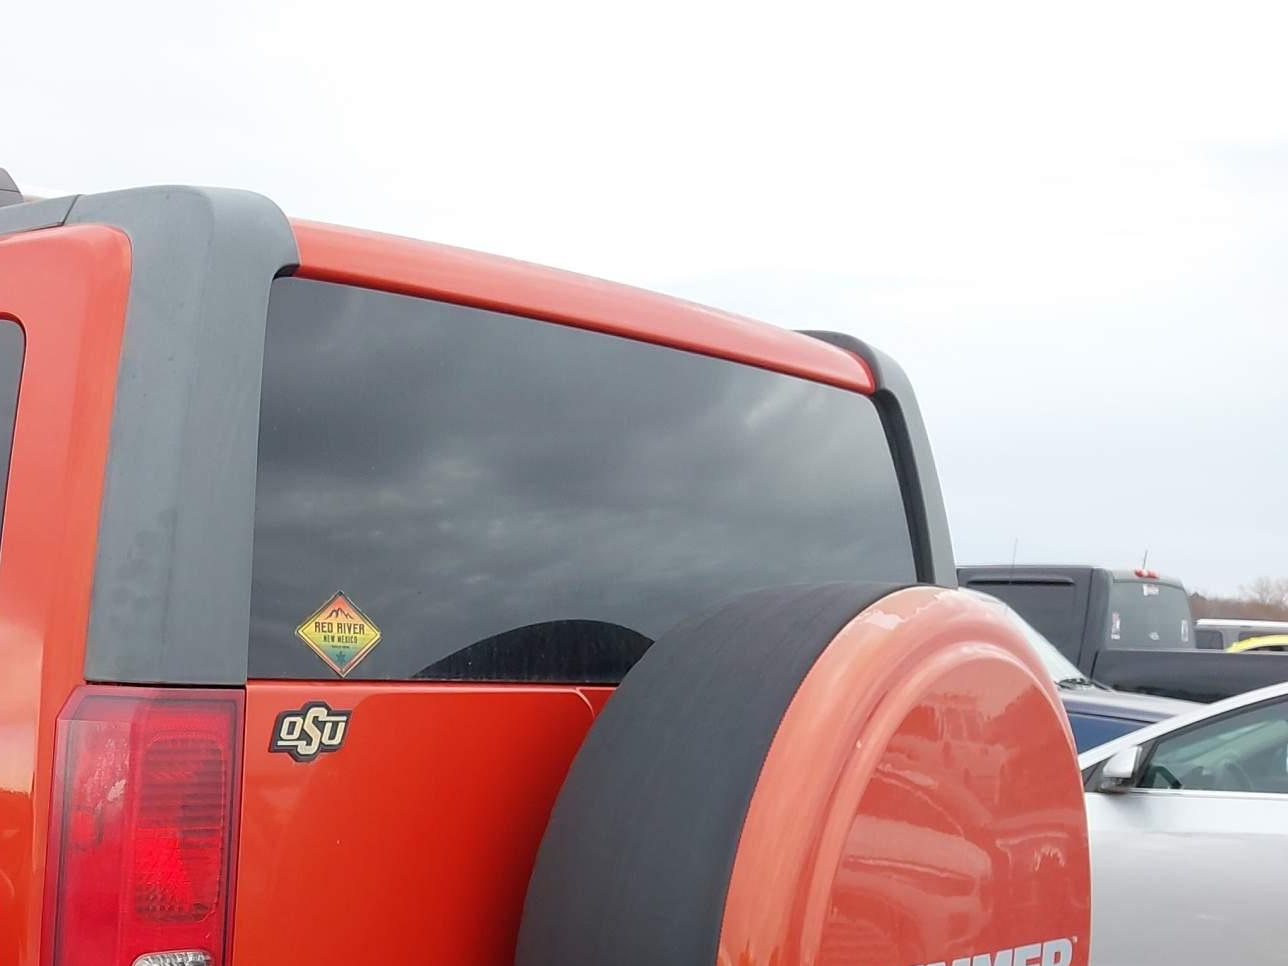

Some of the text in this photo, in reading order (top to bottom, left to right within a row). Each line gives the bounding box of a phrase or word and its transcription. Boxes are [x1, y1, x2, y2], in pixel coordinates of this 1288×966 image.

[314, 621, 365, 636] RED RIVER
[323, 634, 358, 644] NEW MEXICO
[276, 706, 348, 756] OSU
